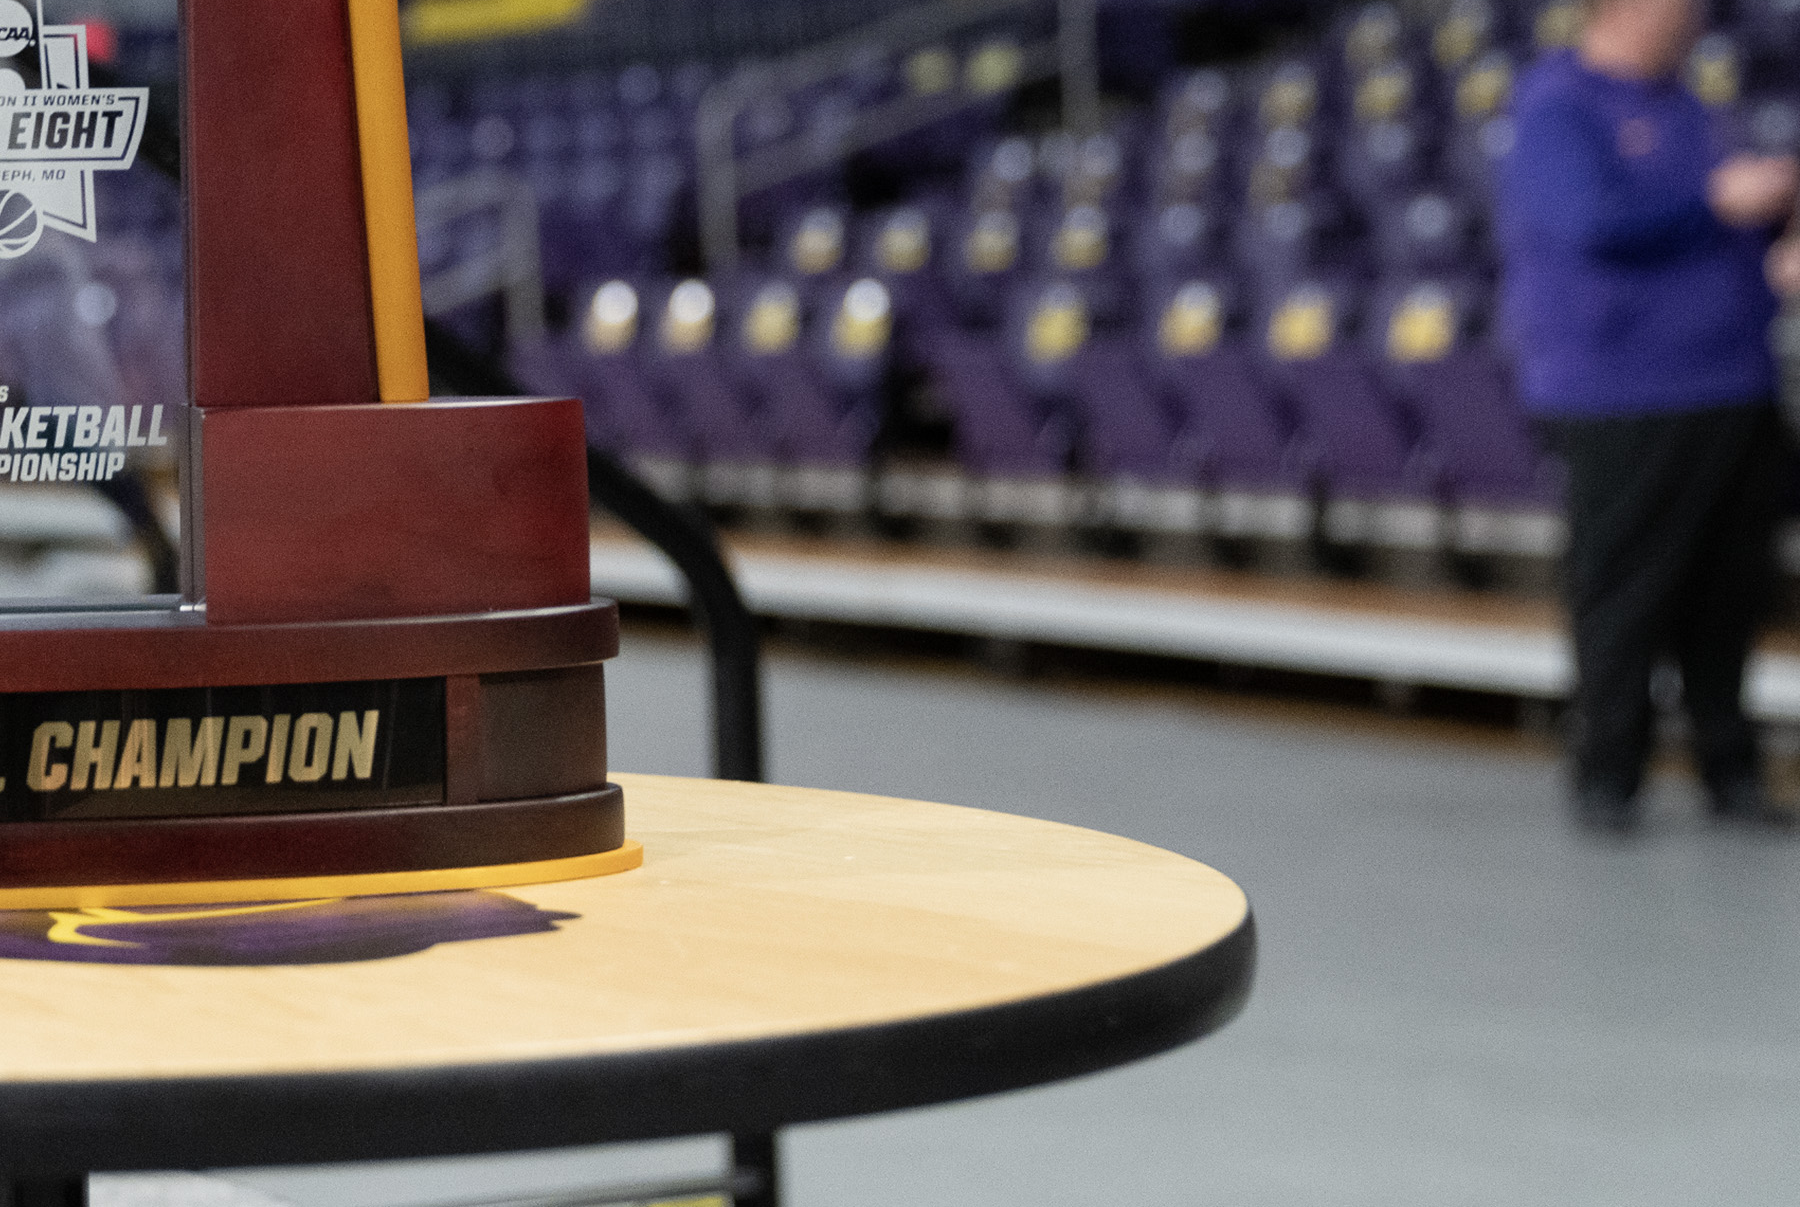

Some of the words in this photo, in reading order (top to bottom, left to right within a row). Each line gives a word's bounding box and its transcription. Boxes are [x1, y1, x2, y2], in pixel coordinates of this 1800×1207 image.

[22, 95, 37, 106] II
[43, 94, 115, 106] WOMEN'S
[7, 111, 123, 150] EIGHT
[41, 170, 66, 181] MO
[26, 709, 380, 792] CHAMPION
